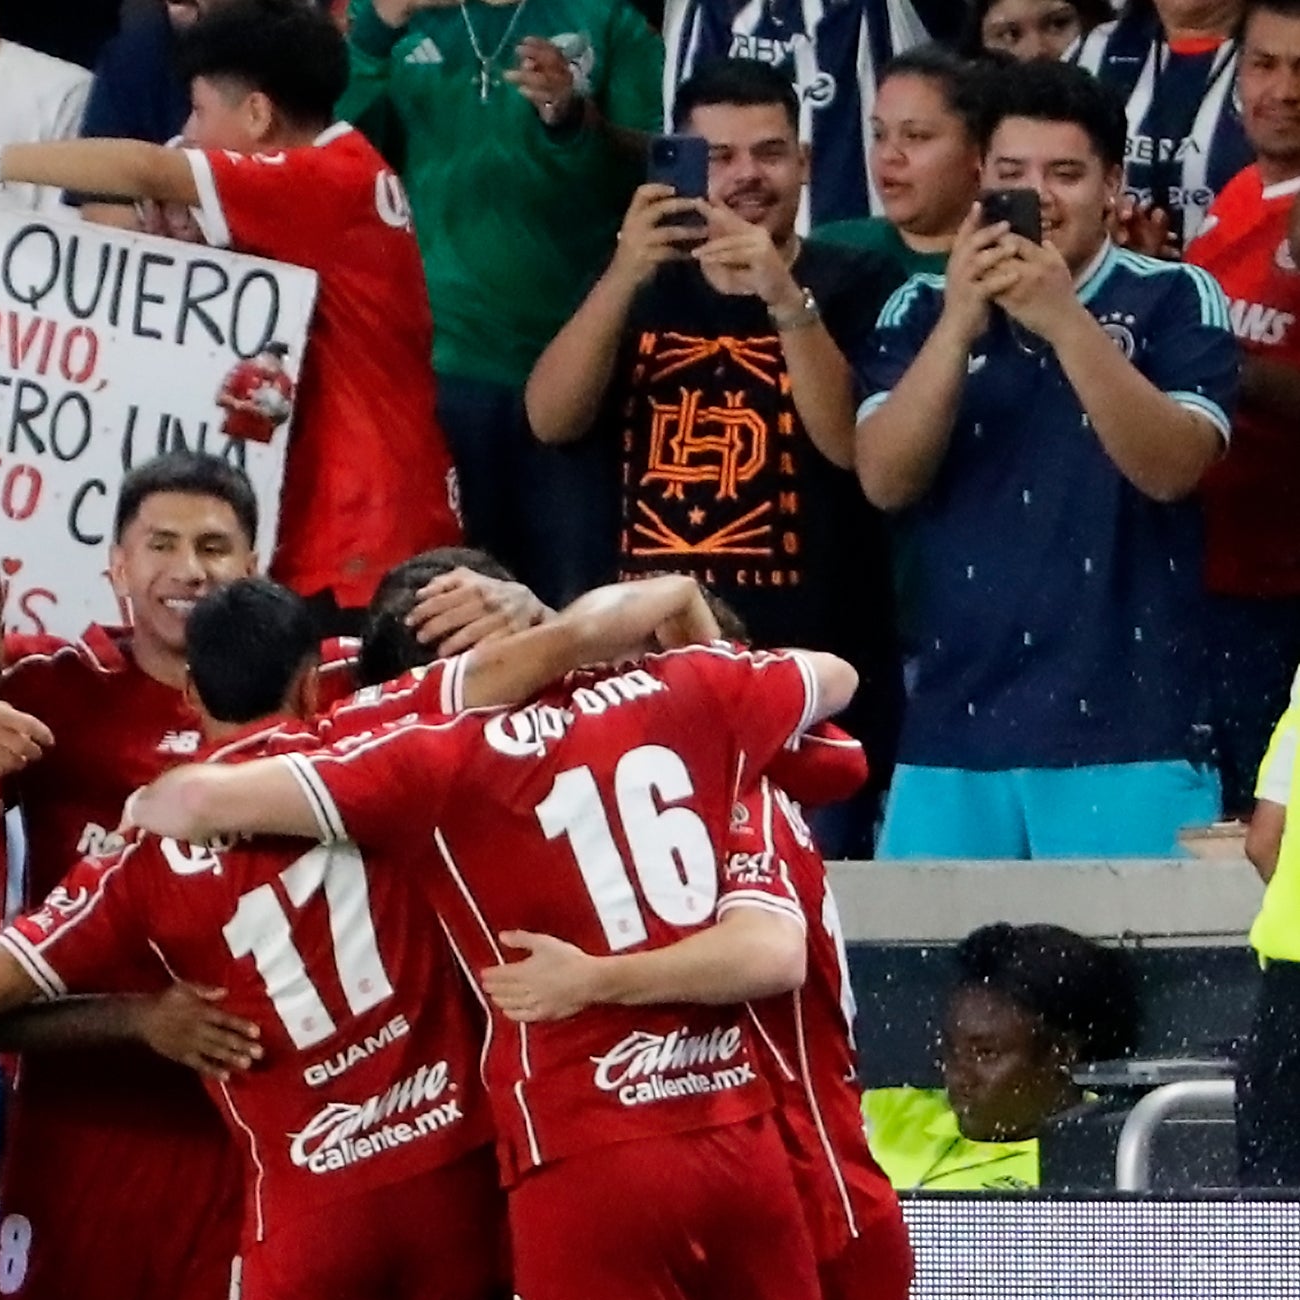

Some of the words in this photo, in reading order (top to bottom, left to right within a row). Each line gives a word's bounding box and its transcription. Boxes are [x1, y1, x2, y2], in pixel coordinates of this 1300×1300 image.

[2, 222, 281, 360] QUIERO
[534, 744, 718, 952] 16
[222, 842, 394, 1051] 17
[303, 1013, 411, 1087] GUAME
[618, 1061, 757, 1107] caliente.mx
[308, 1098, 464, 1174] caliente.mx
